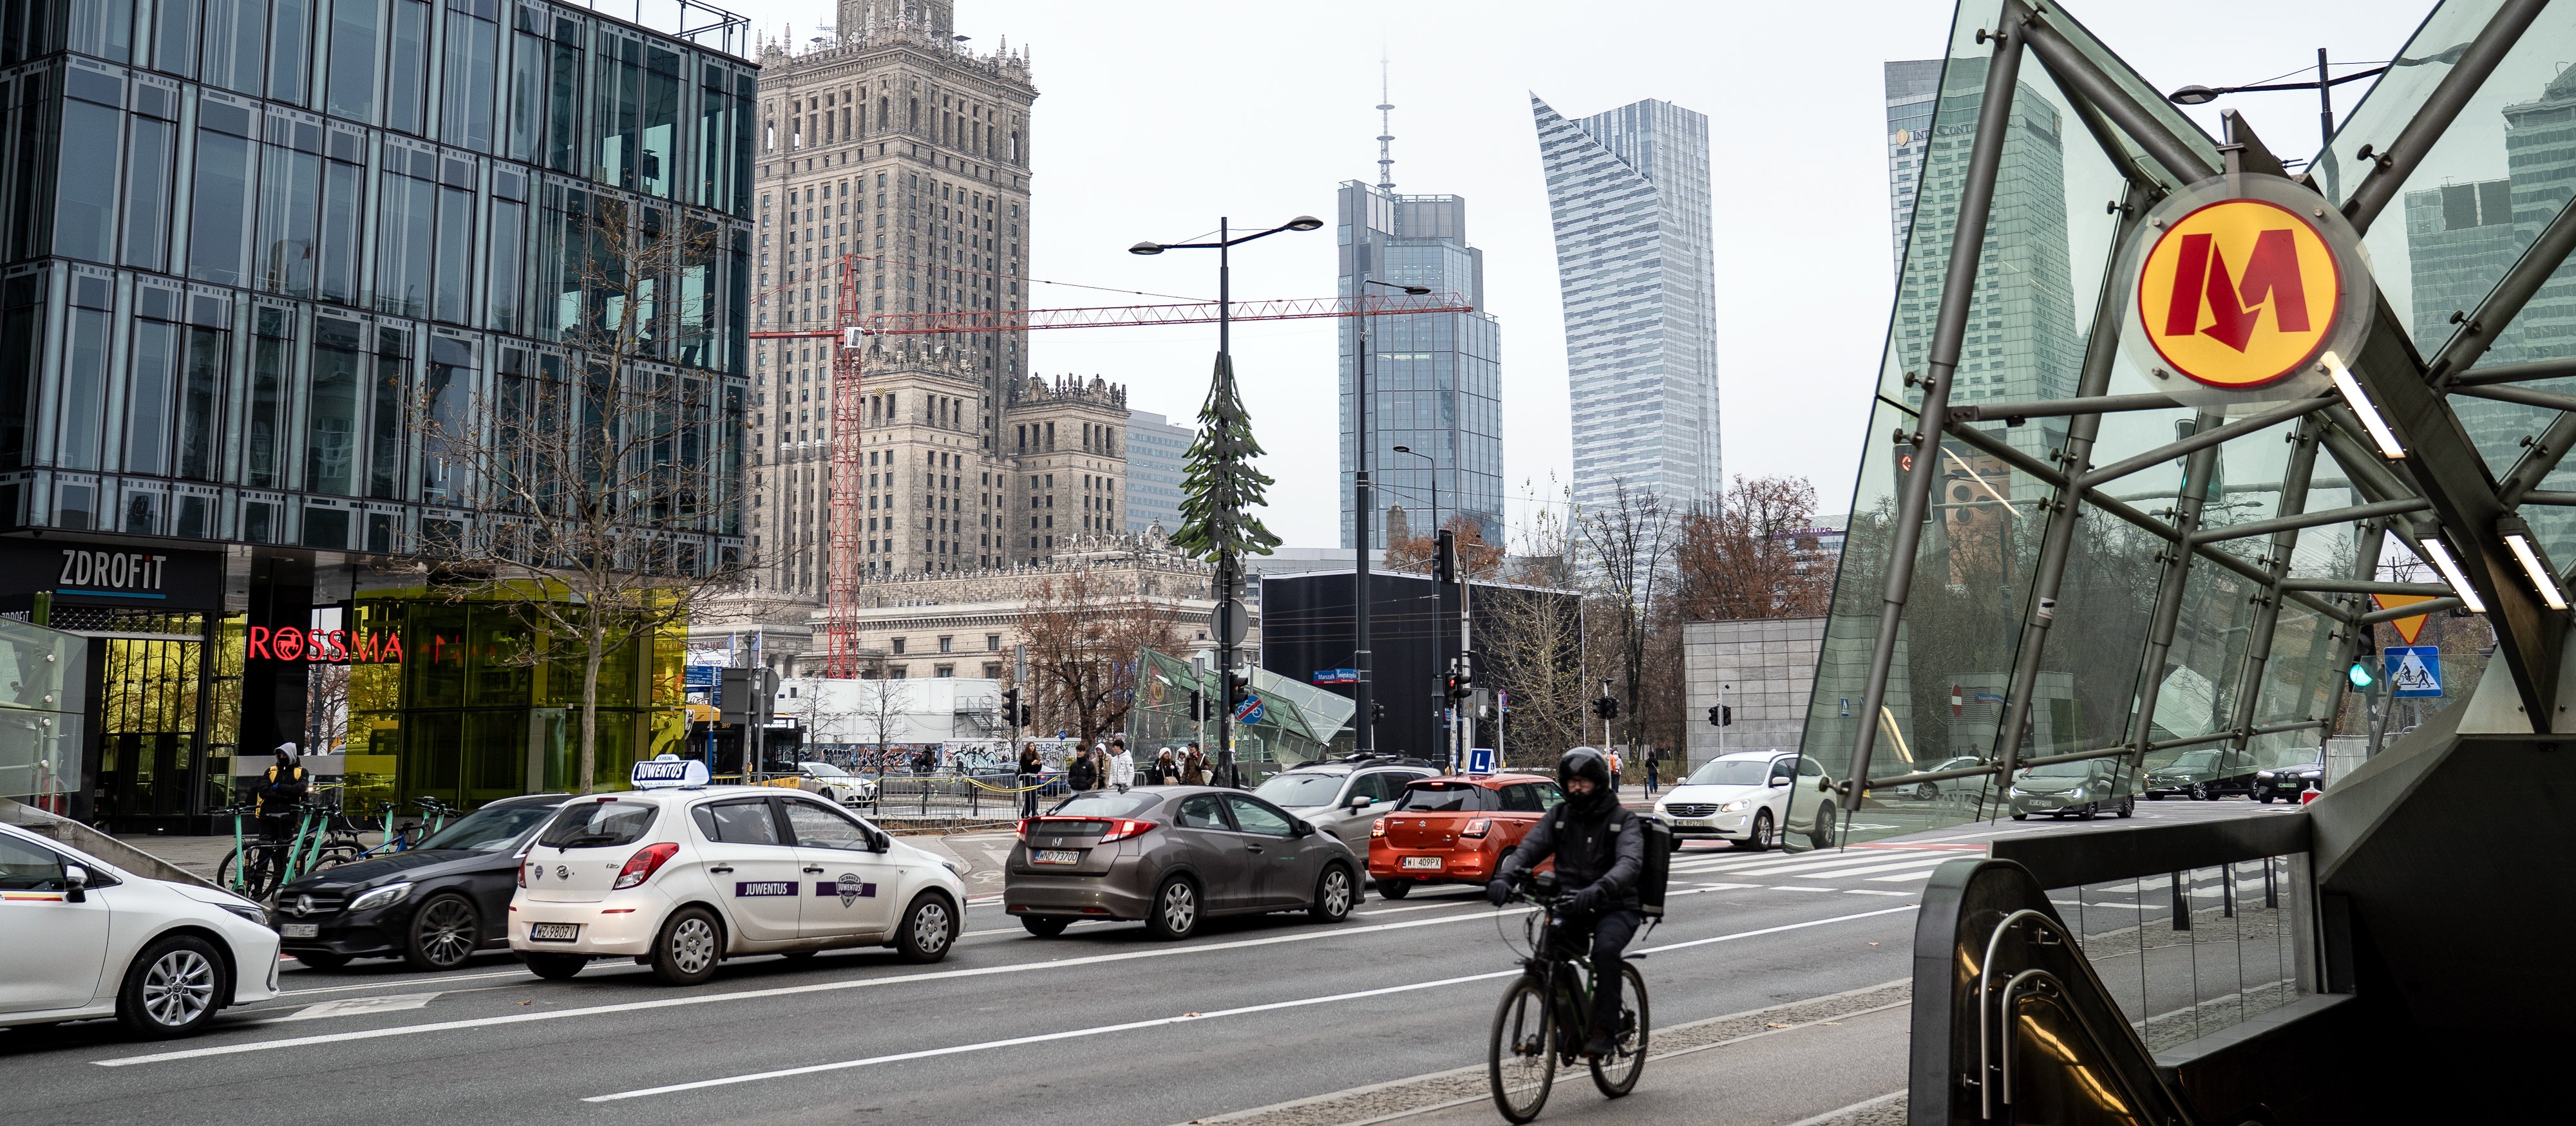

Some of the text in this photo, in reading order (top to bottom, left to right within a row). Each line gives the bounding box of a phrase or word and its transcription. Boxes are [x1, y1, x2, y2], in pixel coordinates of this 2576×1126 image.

[2164, 229, 2311, 353] M
[1475, 753, 1485, 770] L
[637, 762, 687, 780] JUWENTUS
[1039, 851, 1078, 861] WND 73700
[1407, 858, 1439, 867] WI 409PX
[745, 883, 788, 896] JUWENTUS
[838, 883, 862, 892] JUWENTUS
[536, 925, 575, 939] WZ 9807V
